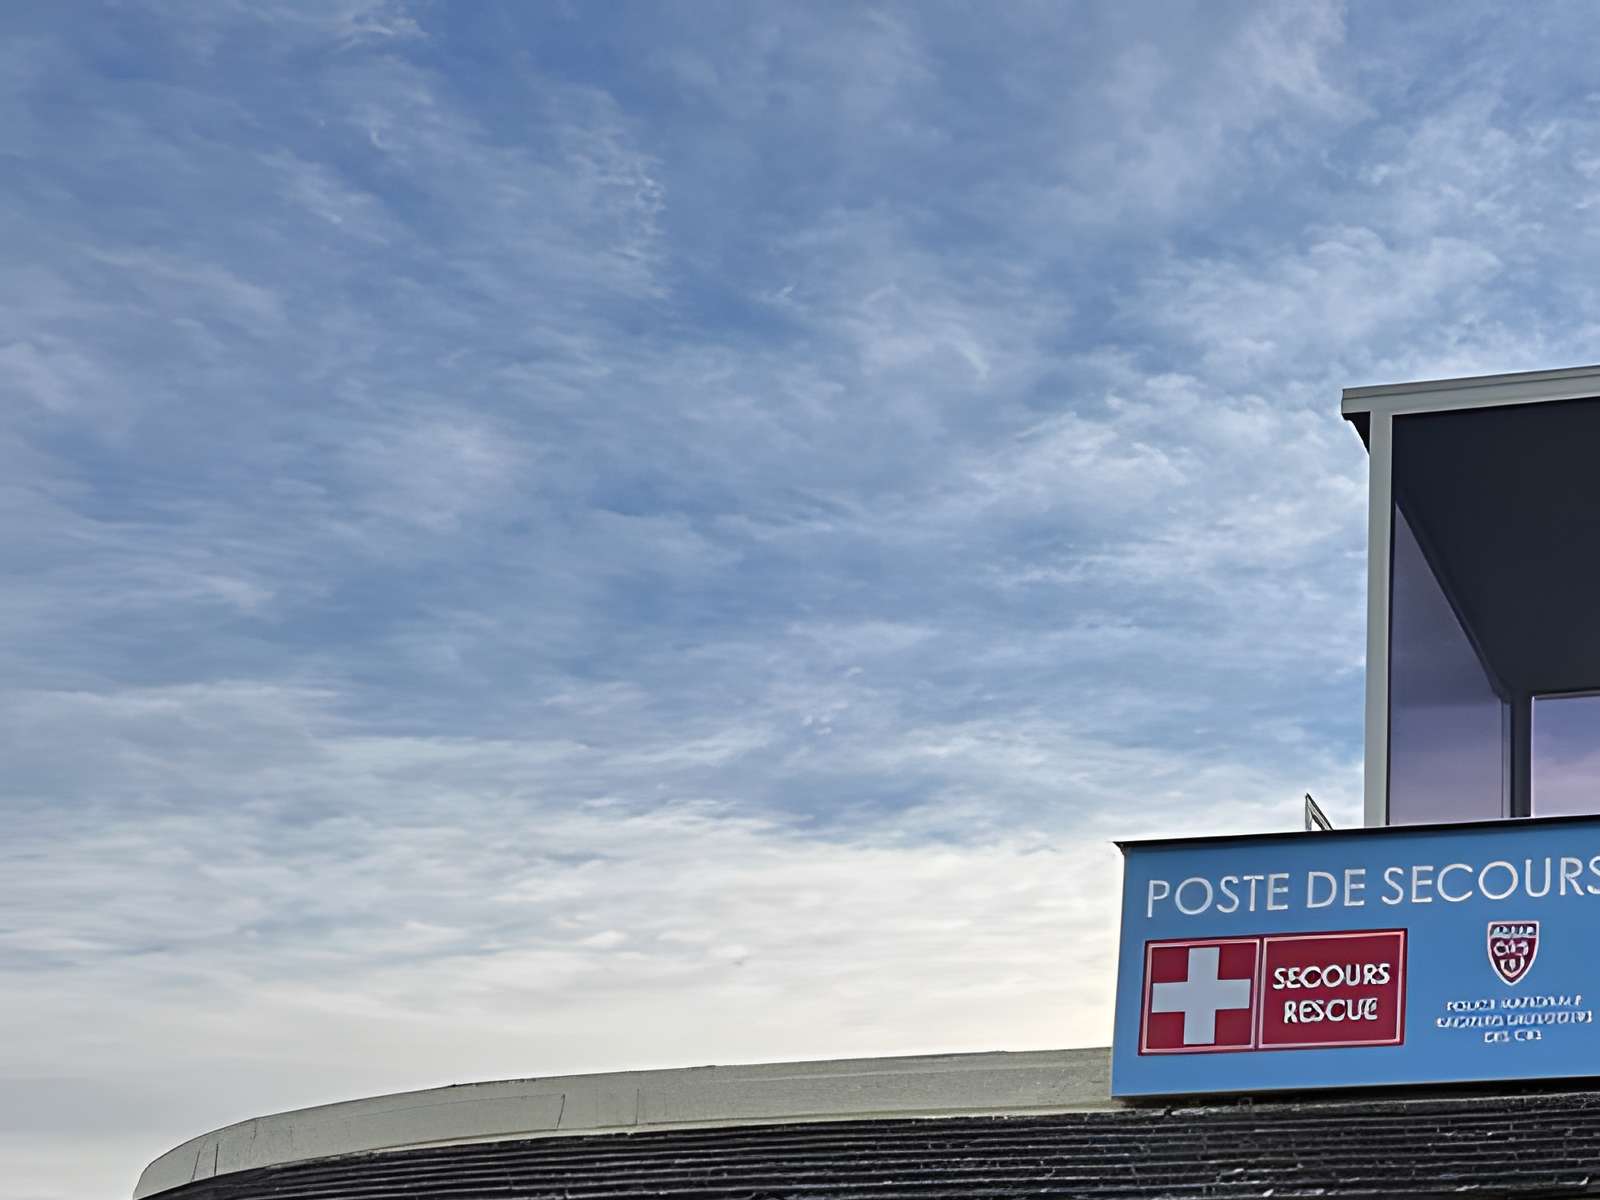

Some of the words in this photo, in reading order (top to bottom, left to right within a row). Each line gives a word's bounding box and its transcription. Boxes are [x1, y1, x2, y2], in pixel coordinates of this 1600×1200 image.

[1146, 872, 1290, 918] POSTE
[1306, 868, 1366, 909] DE
[1272, 963, 1391, 990] SECOURS
[1283, 997, 1378, 1024] RESCUE
